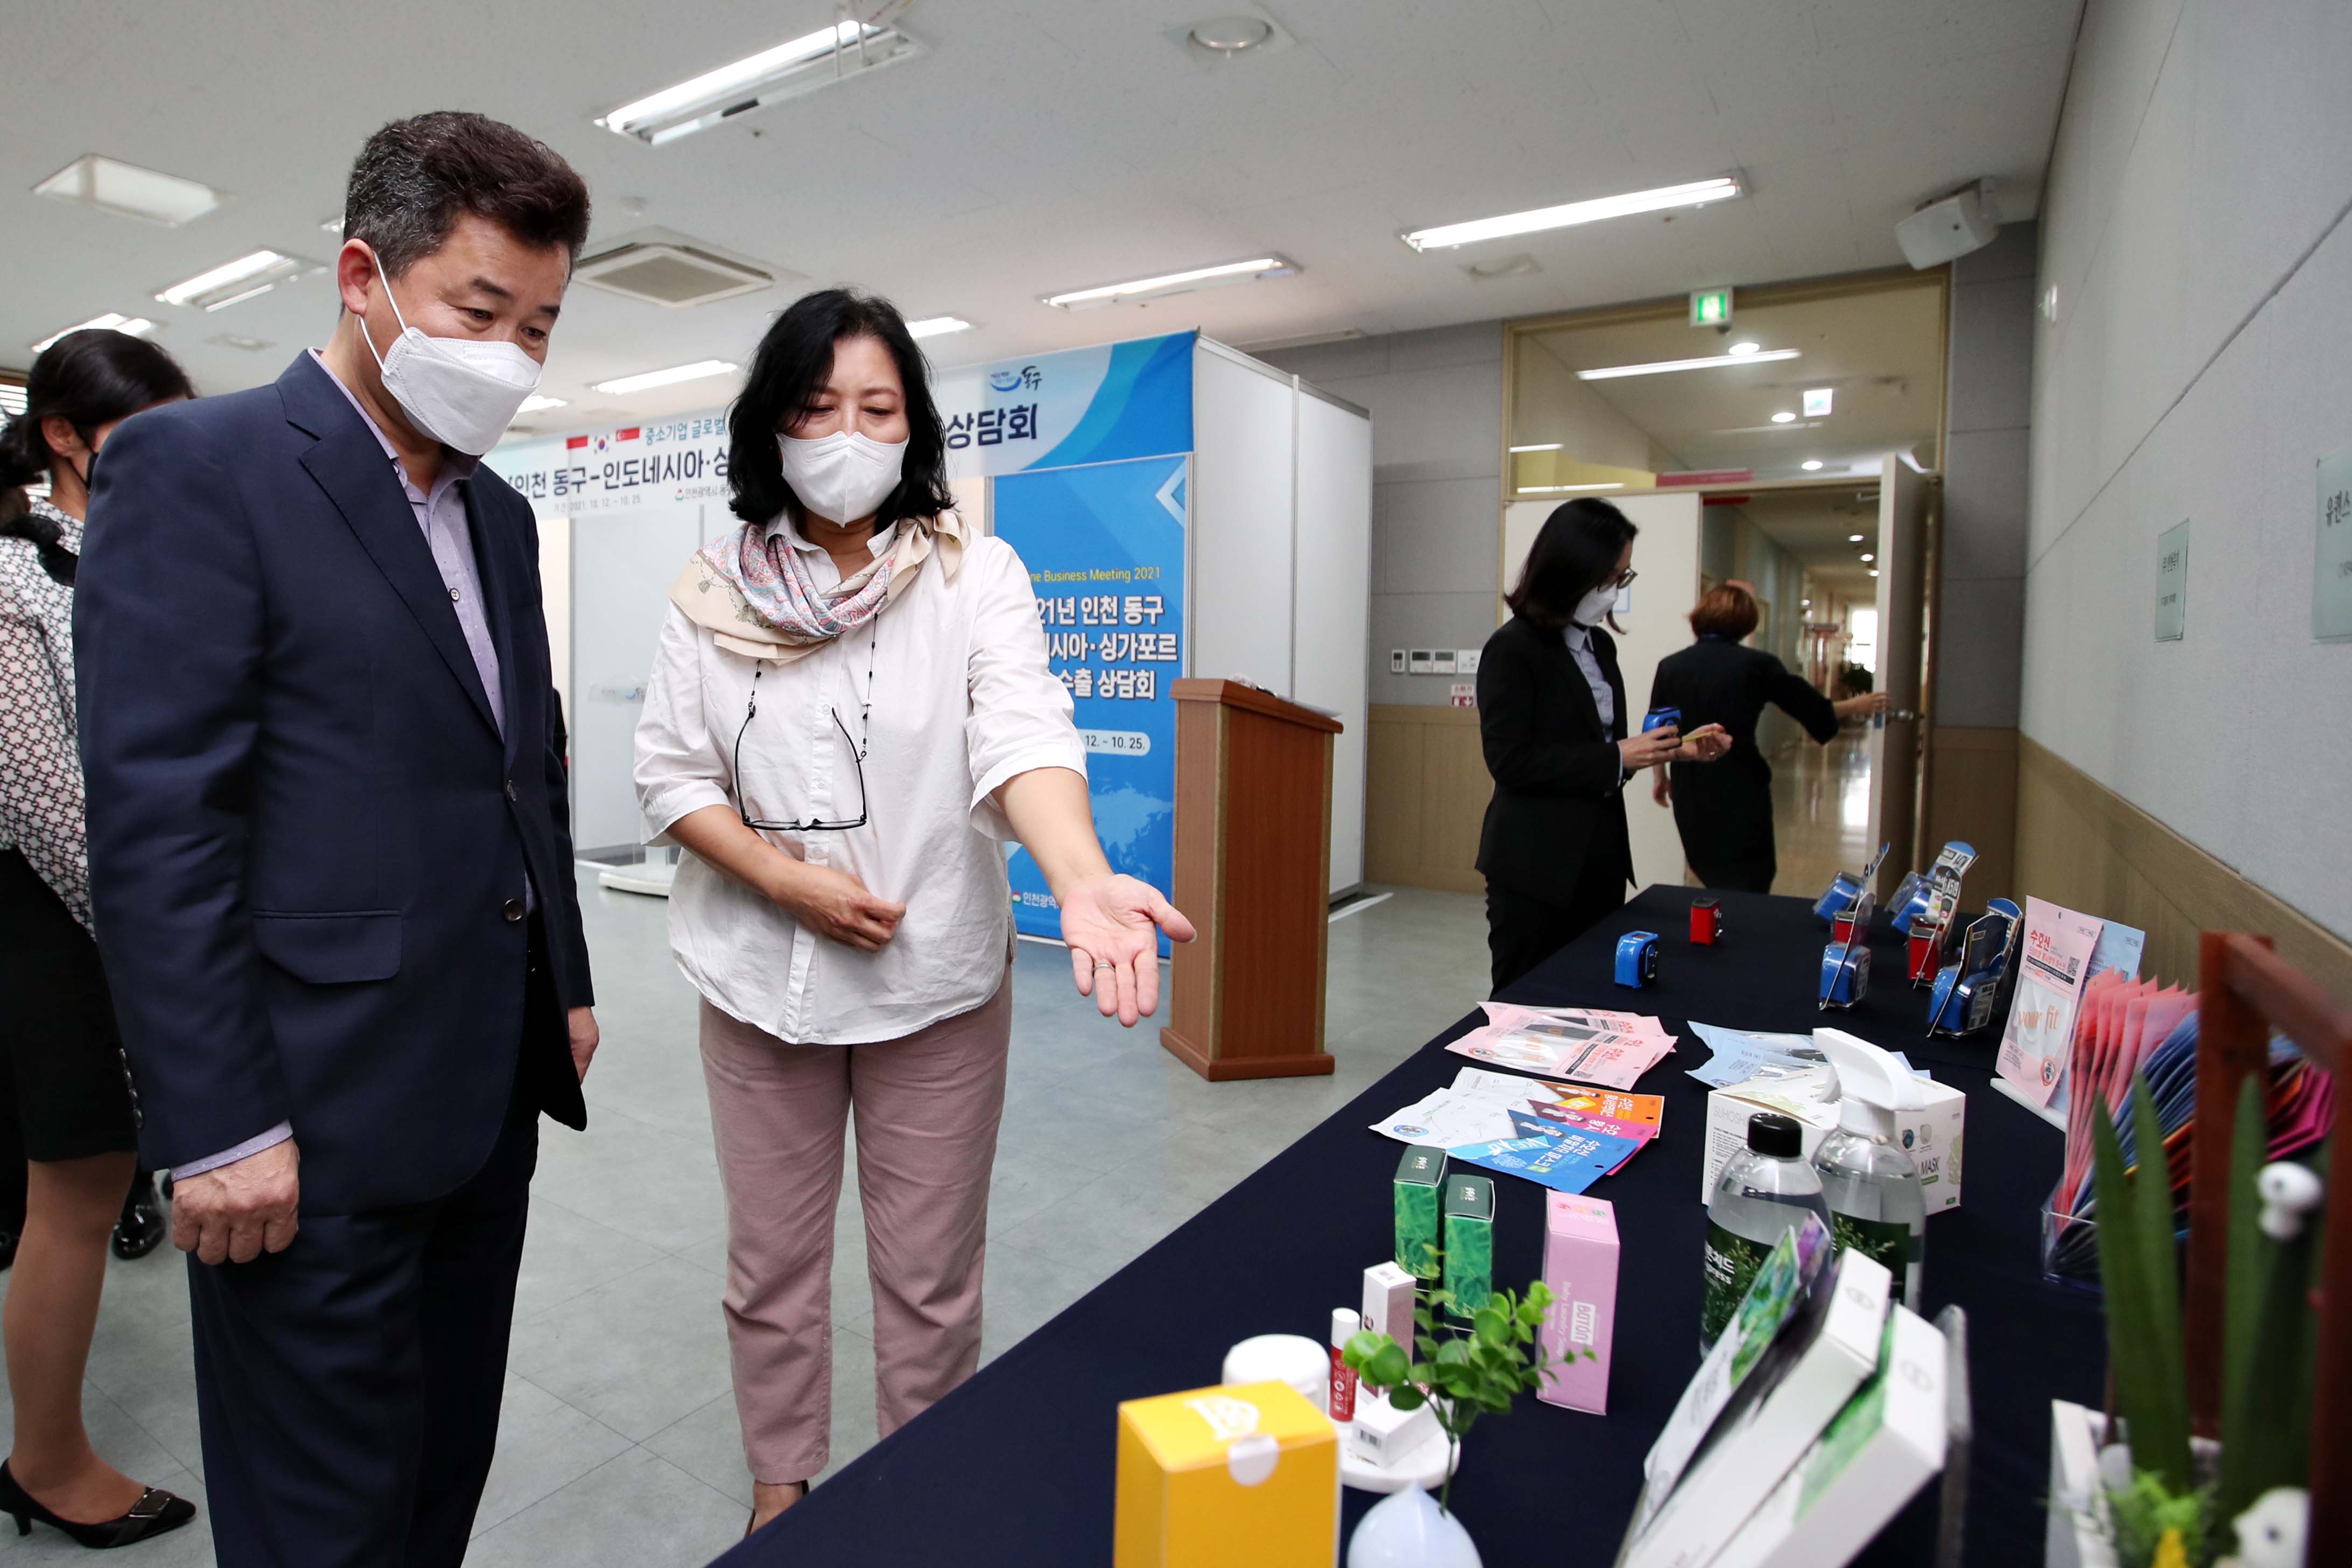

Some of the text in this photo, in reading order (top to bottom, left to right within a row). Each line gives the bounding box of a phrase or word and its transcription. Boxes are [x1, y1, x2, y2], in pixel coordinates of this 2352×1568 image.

[646, 418, 724, 446] 중소기업 글로벌
[514, 471, 547, 499] 인천
[946, 403, 1038, 450] 상담회
[1030, 566, 1161, 583] ne Business Meeting 2021
[1081, 594, 1118, 626] 인천
[1124, 596, 1164, 626] 동구
[1097, 669, 1155, 700] 상담회
[1112, 736, 1126, 748] 10.
[1129, 737, 1145, 750] 25.
[1023, 892, 1059, 909] 인천광역
[2030, 929, 2051, 952] 수호신
[1572, 1139, 1601, 1157] 수호신
[1534, 1151, 1562, 1166] 마스크
[1920, 1156, 1941, 1175] MASK
